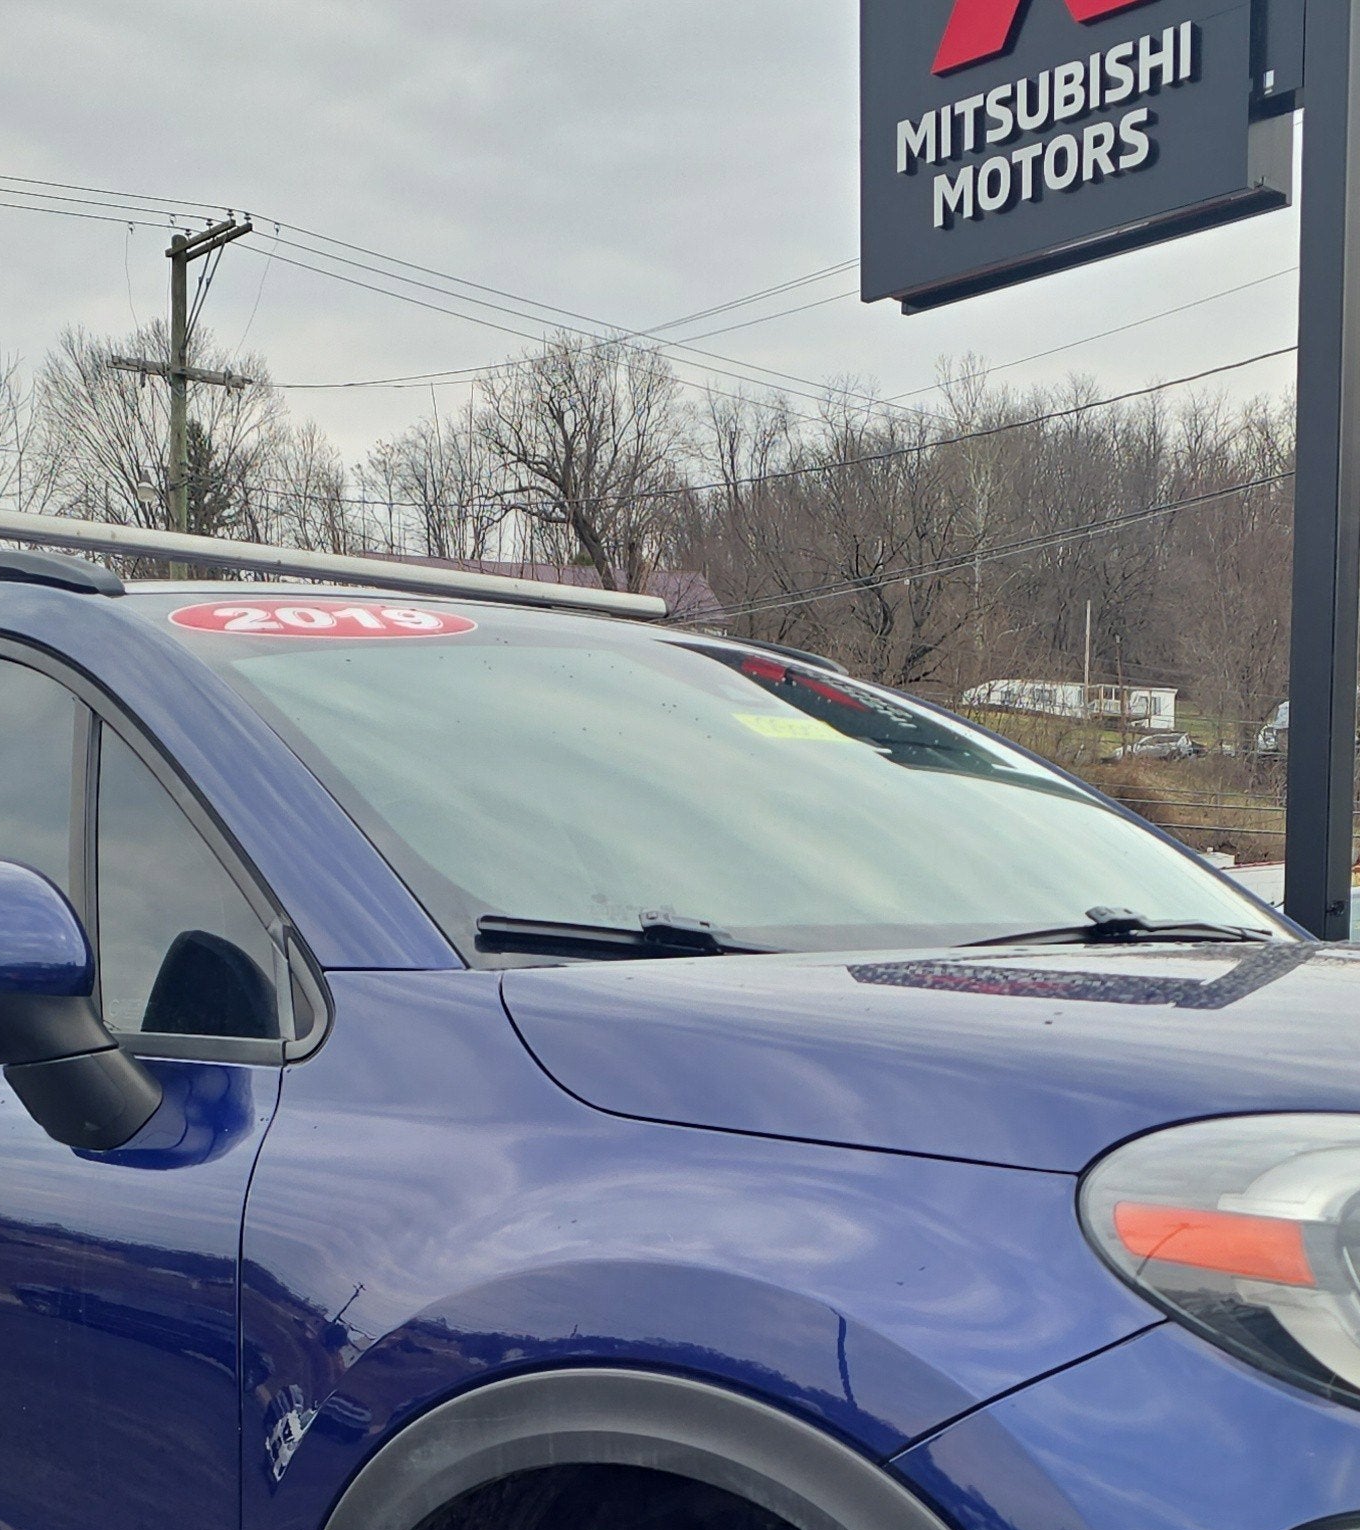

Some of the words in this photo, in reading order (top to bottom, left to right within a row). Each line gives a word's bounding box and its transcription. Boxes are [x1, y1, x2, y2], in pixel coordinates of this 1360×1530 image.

[896, 20, 1192, 174] MITSUBISHI
[933, 107, 1151, 229] MOTORS
[213, 606, 444, 632] 2019
